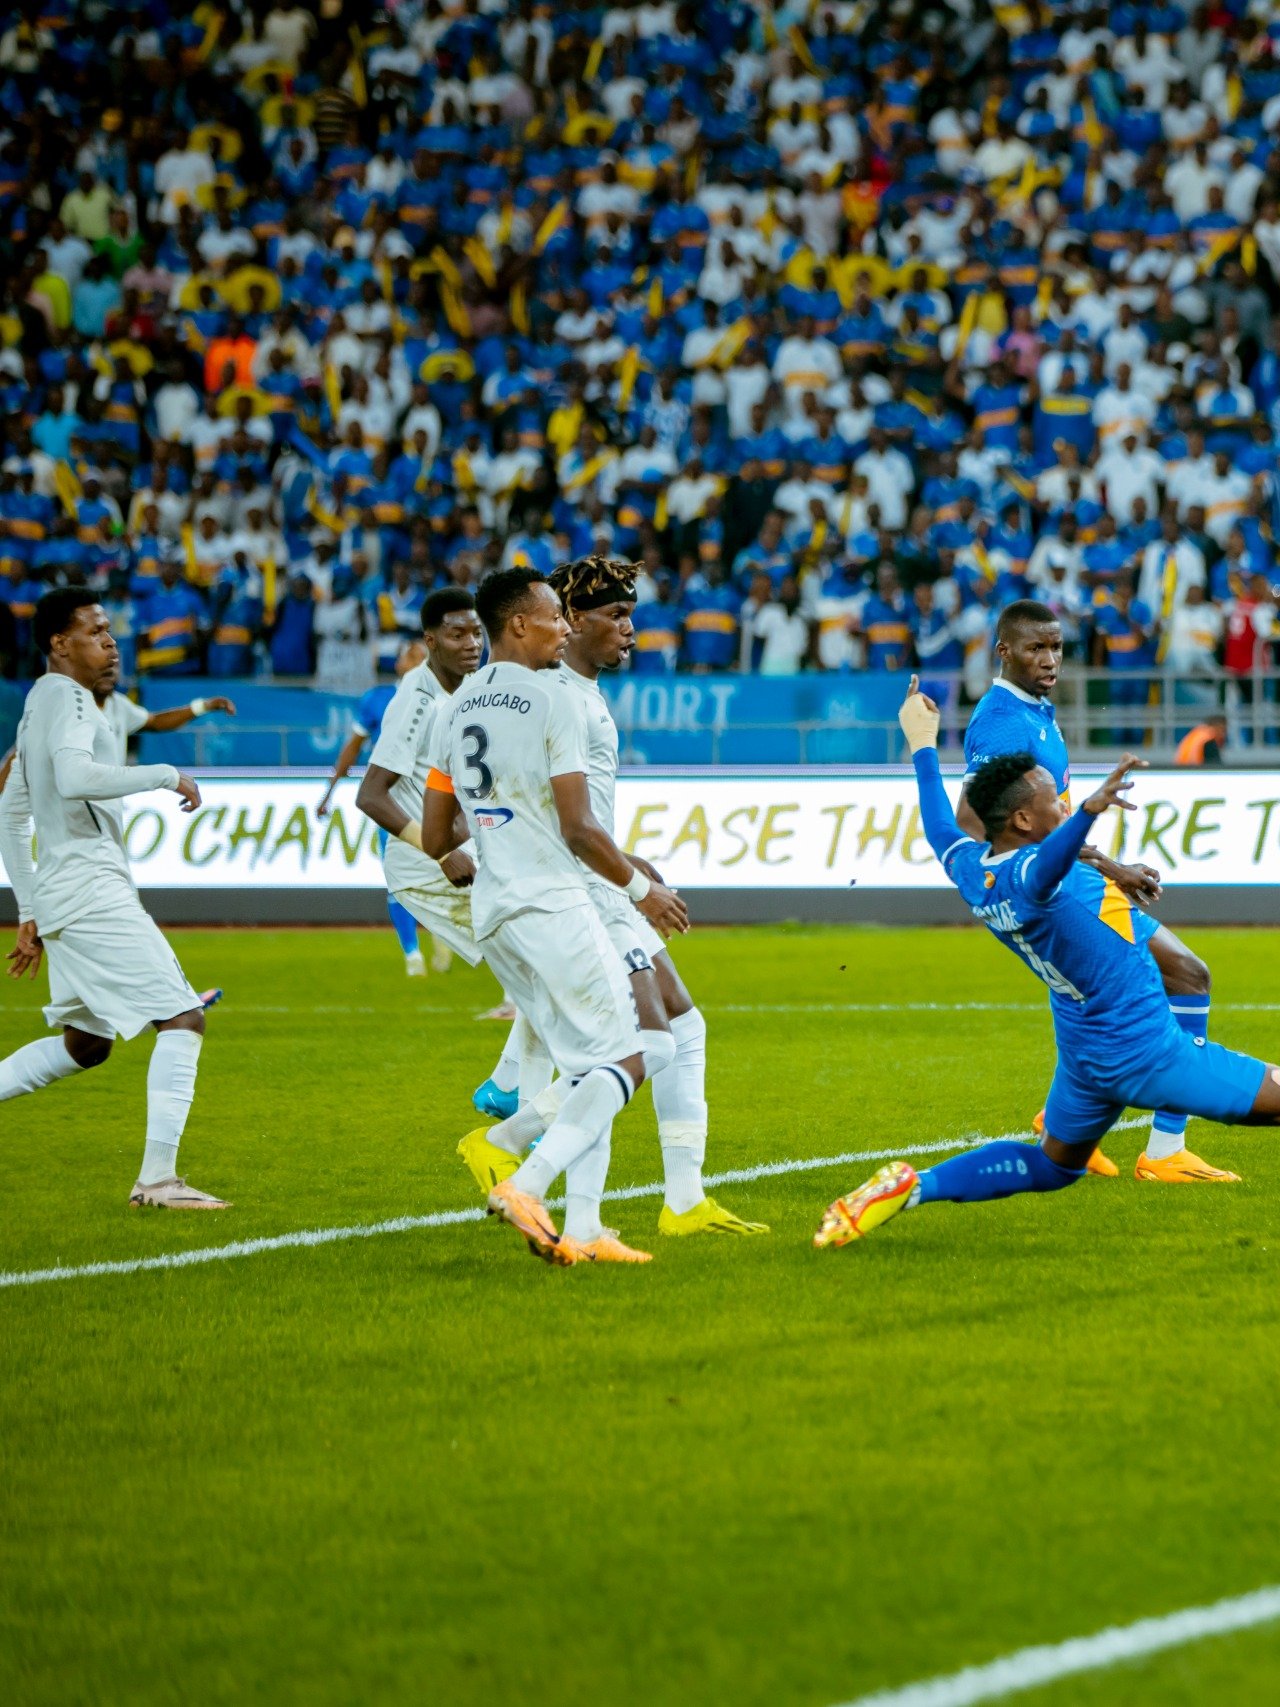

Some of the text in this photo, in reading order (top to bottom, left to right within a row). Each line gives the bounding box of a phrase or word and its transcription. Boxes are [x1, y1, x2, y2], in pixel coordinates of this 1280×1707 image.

[461, 723, 494, 801] 3
[182, 803, 385, 872] CHAN
[619, 802, 801, 868] EASE
